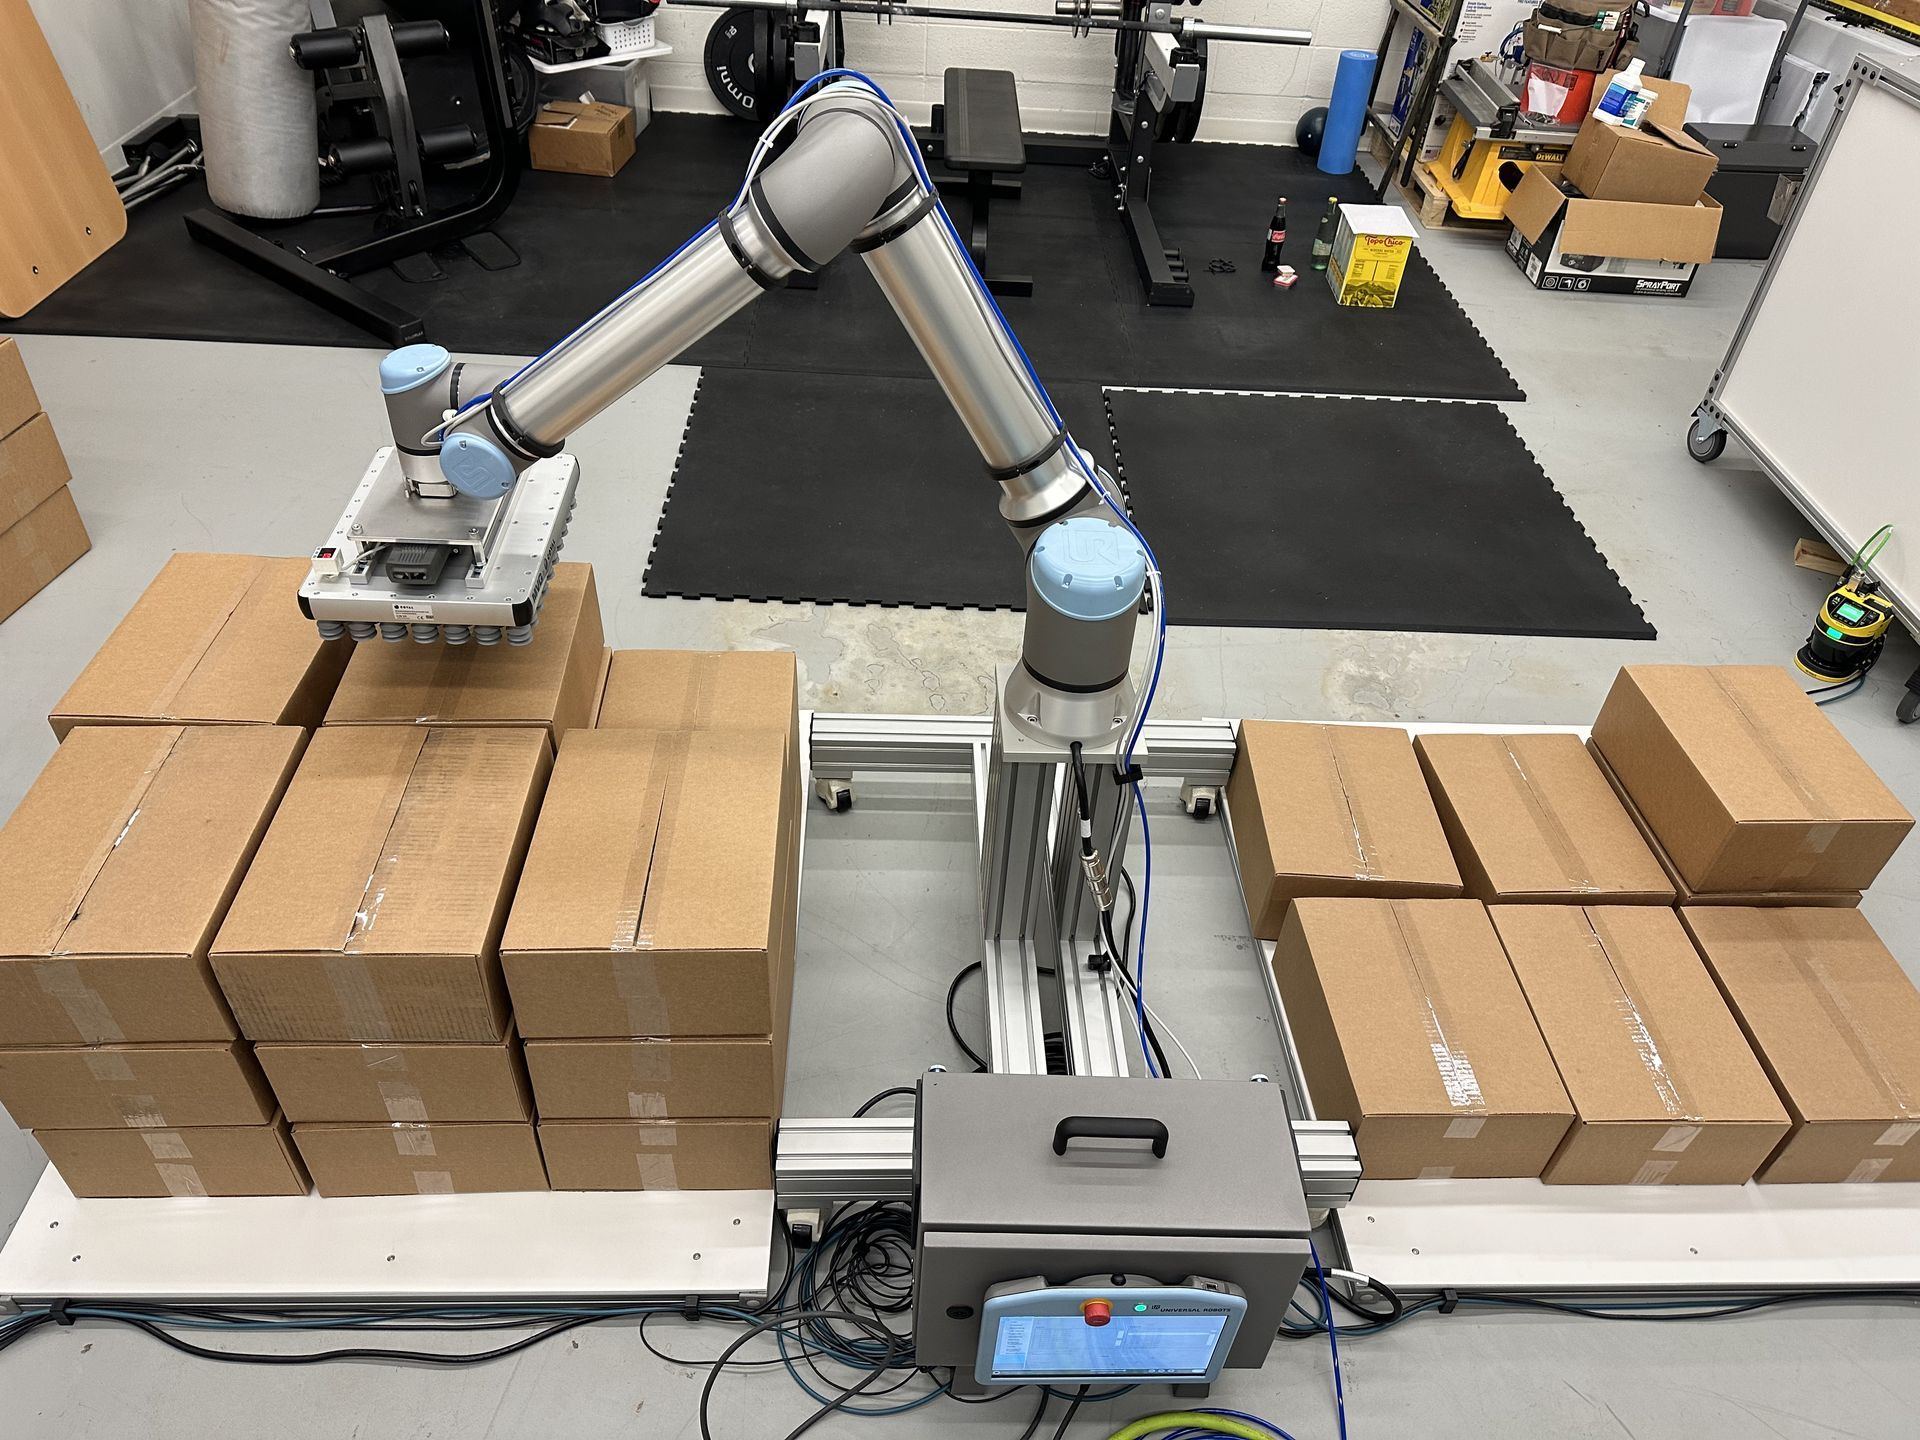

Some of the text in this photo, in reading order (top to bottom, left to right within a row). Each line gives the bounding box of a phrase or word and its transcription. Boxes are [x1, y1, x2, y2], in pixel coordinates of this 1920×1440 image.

[729, 25, 738, 36] 10
[1365, 235, 1406, 248] Topo Chico
